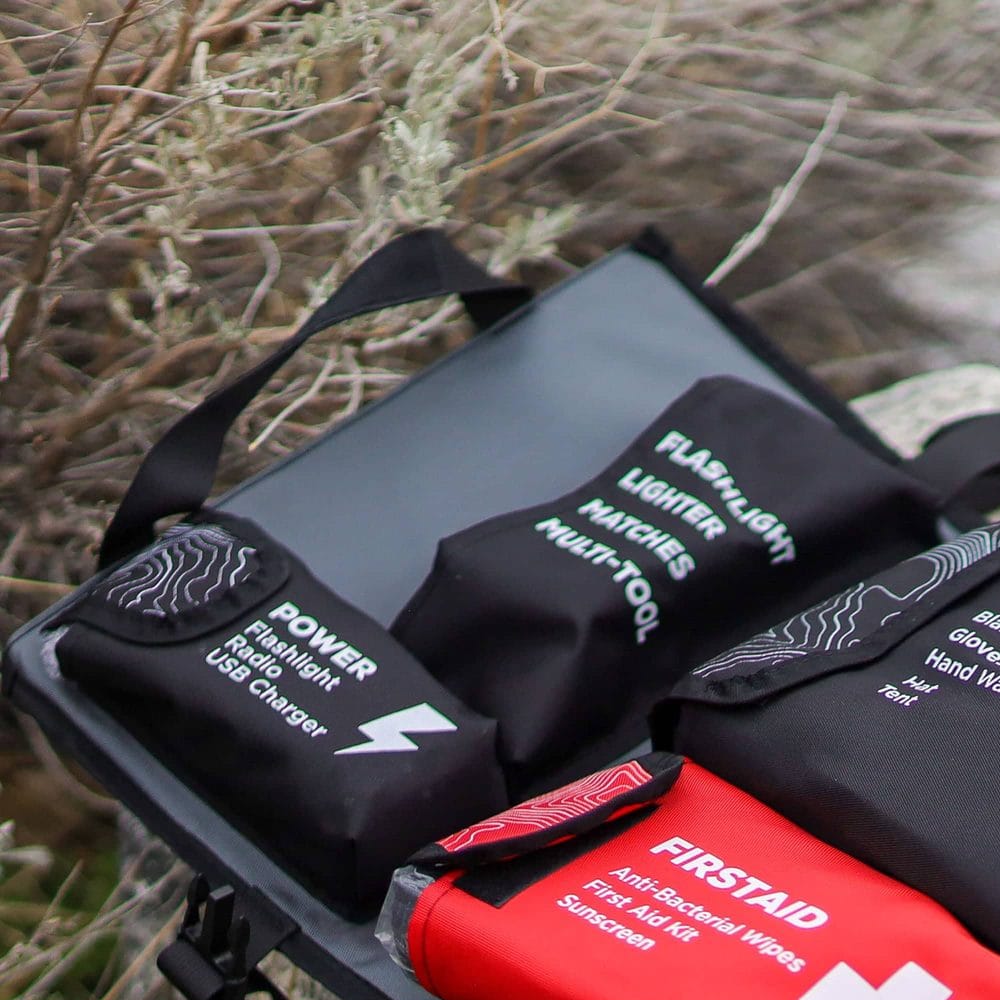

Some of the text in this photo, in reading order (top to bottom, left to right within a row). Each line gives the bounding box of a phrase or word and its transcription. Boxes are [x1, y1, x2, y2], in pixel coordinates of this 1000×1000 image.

[617, 466, 727, 541] LIGHTER
[654, 429, 796, 565] FLASHLIGHT
[577, 497, 695, 581] MATCHES
[535, 516, 659, 644] MULTI-TOOL
[223, 633, 283, 679] Radio
[244, 619, 341, 692] Flashlight
[268, 600, 377, 682] POWER
[924, 648, 979, 682] Hand
[205, 646, 329, 738] USB Charger
[877, 683, 919, 707] Tent
[556, 894, 656, 952] Sunscreen
[582, 878, 700, 943] First Aid Kit
[608, 866, 806, 973] Anti-Bacterial Wipes
